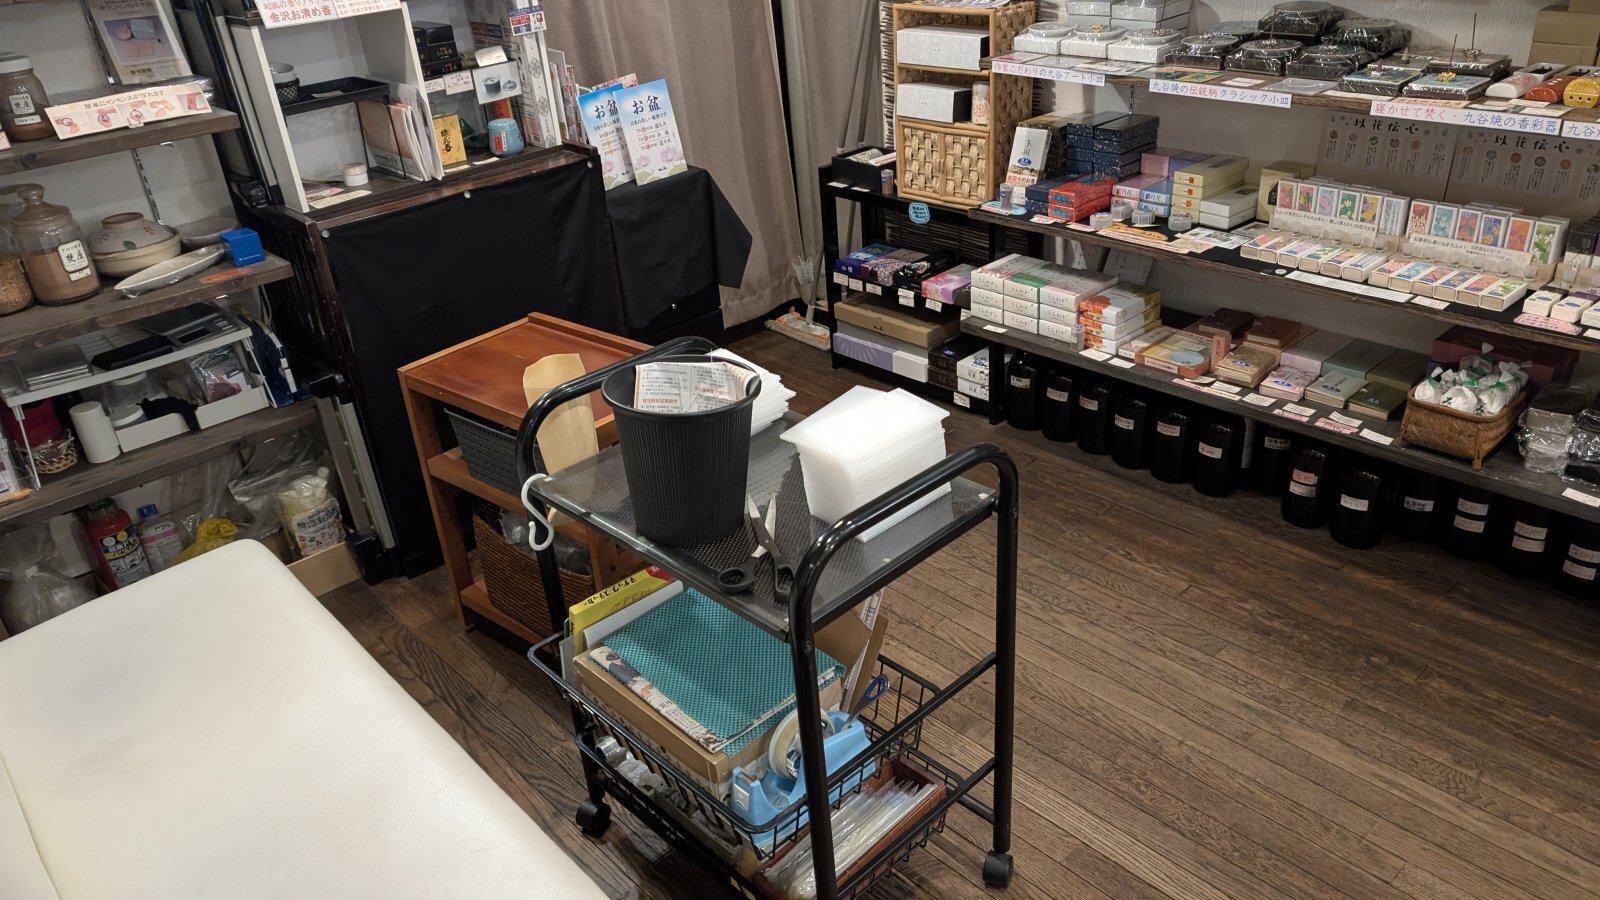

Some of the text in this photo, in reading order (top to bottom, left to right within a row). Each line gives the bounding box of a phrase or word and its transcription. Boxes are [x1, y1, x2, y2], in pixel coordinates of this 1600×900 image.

[269, 5, 332, 23] 金沢お清め香
[994, 63, 1104, 86] 作家こだわりの九谷アート小皿
[632, 95, 661, 114] お盆
